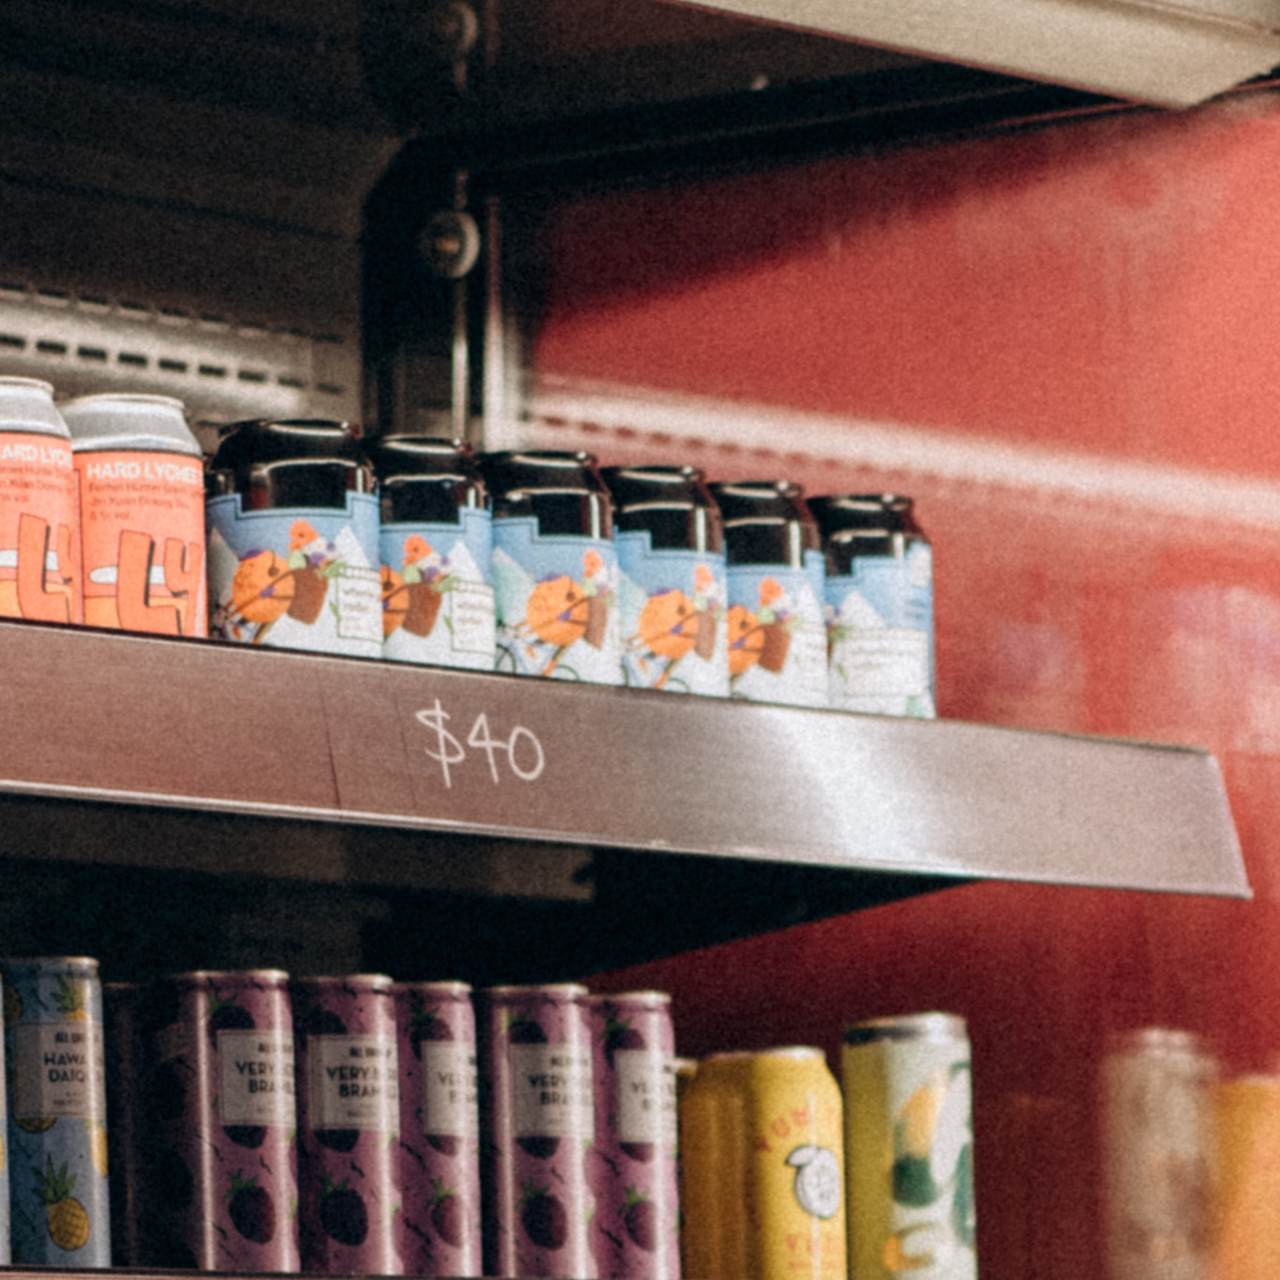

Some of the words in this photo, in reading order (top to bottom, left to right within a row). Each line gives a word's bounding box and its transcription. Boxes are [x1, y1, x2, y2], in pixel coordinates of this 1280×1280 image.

[0, 444, 38, 462] ARD
[87, 461, 140, 479] HARD
[416, 698, 545, 789] $40
